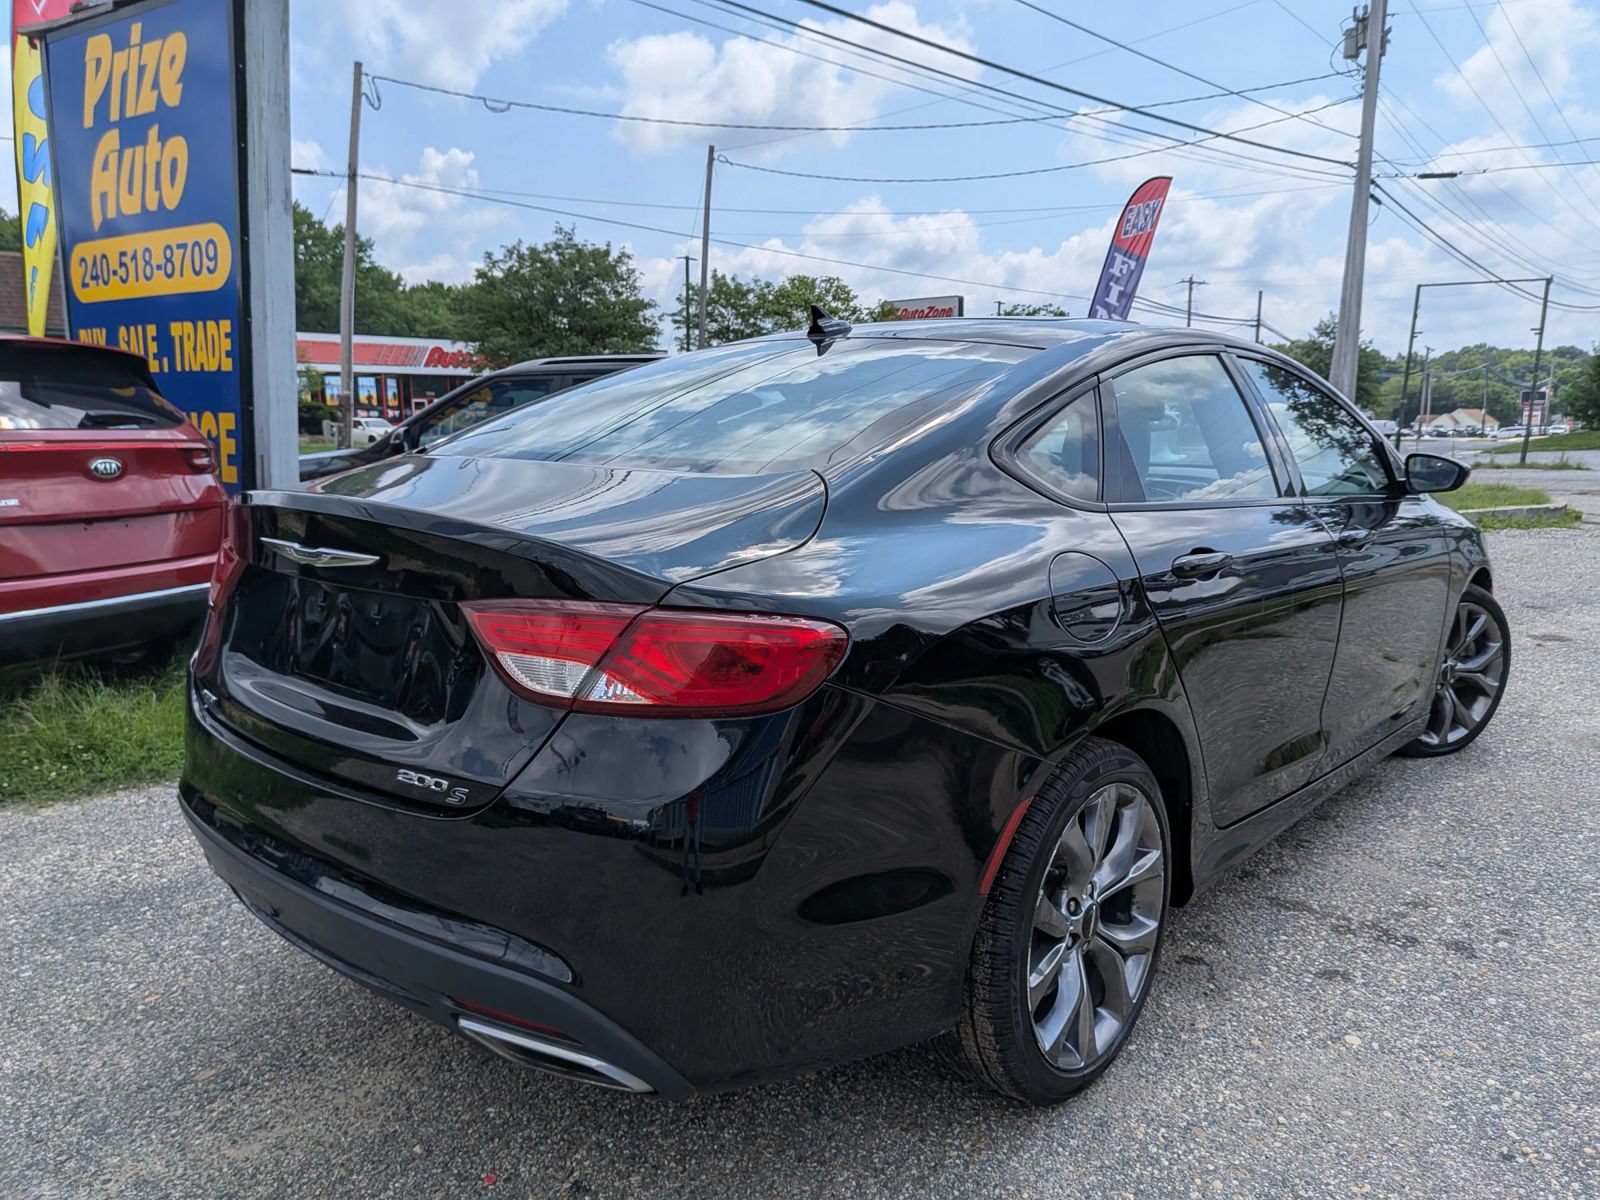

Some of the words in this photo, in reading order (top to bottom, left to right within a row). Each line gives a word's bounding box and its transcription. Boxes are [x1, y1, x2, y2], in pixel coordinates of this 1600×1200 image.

[83, 22, 188, 129] Prize
[91, 124, 188, 232] Auto
[1121, 198, 1163, 239] EASY
[79, 238, 219, 289] 240-518-8709
[900, 305, 954, 320] AutoZone
[170, 319, 233, 372] TRADE
[96, 461, 119, 475] KIA
[397, 768, 449, 793] 200
[446, 787, 469, 805] S
